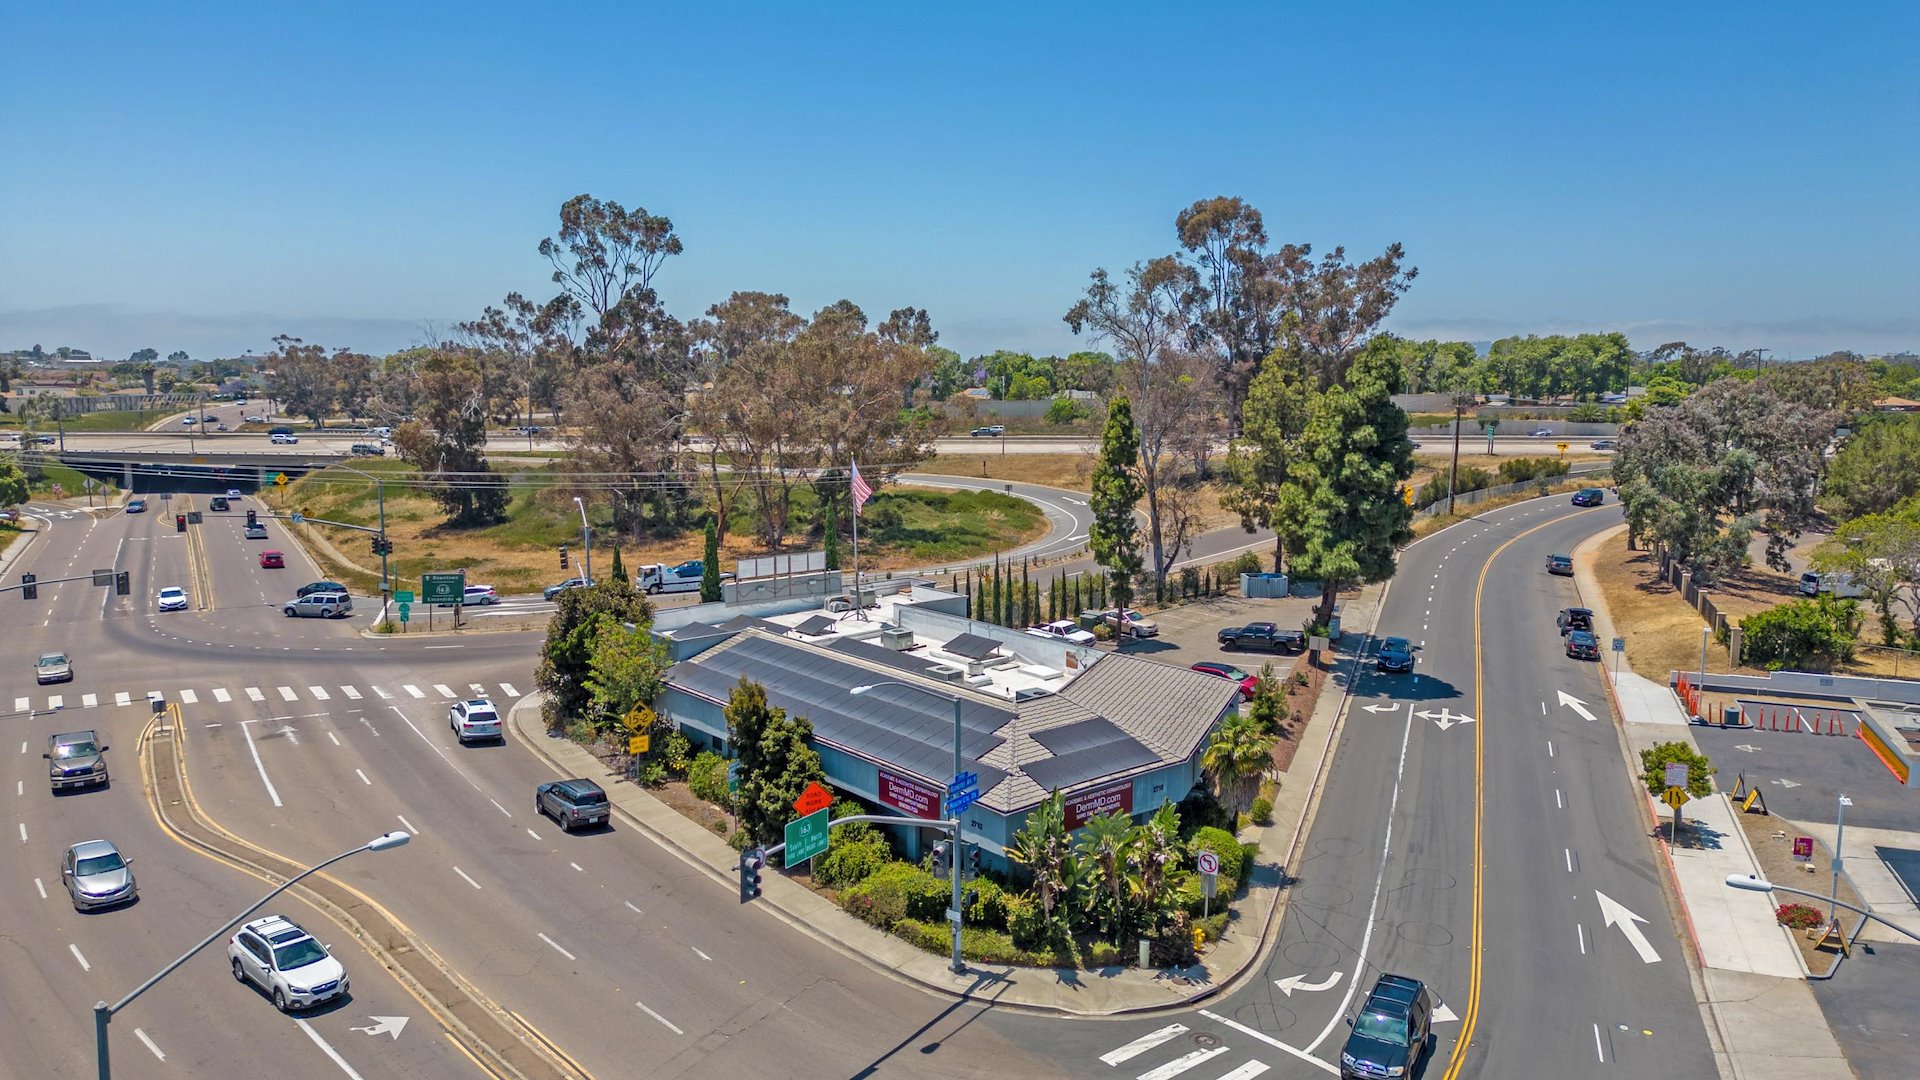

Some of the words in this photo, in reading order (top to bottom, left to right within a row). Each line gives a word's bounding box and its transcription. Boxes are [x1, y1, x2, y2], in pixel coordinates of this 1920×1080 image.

[629, 713, 648, 725] 15-2
[888, 781, 929, 806] DermMD.com
[1153, 784, 1164, 793] 2710
[806, 791, 821, 799] ROAD
[806, 799, 822, 807] WORK
[1076, 794, 1121, 814] DermMD.com
[801, 823, 811, 834] 163
[971, 820, 983, 830] 2710
[811, 832, 823, 842] North
[790, 842, 802, 852] South
